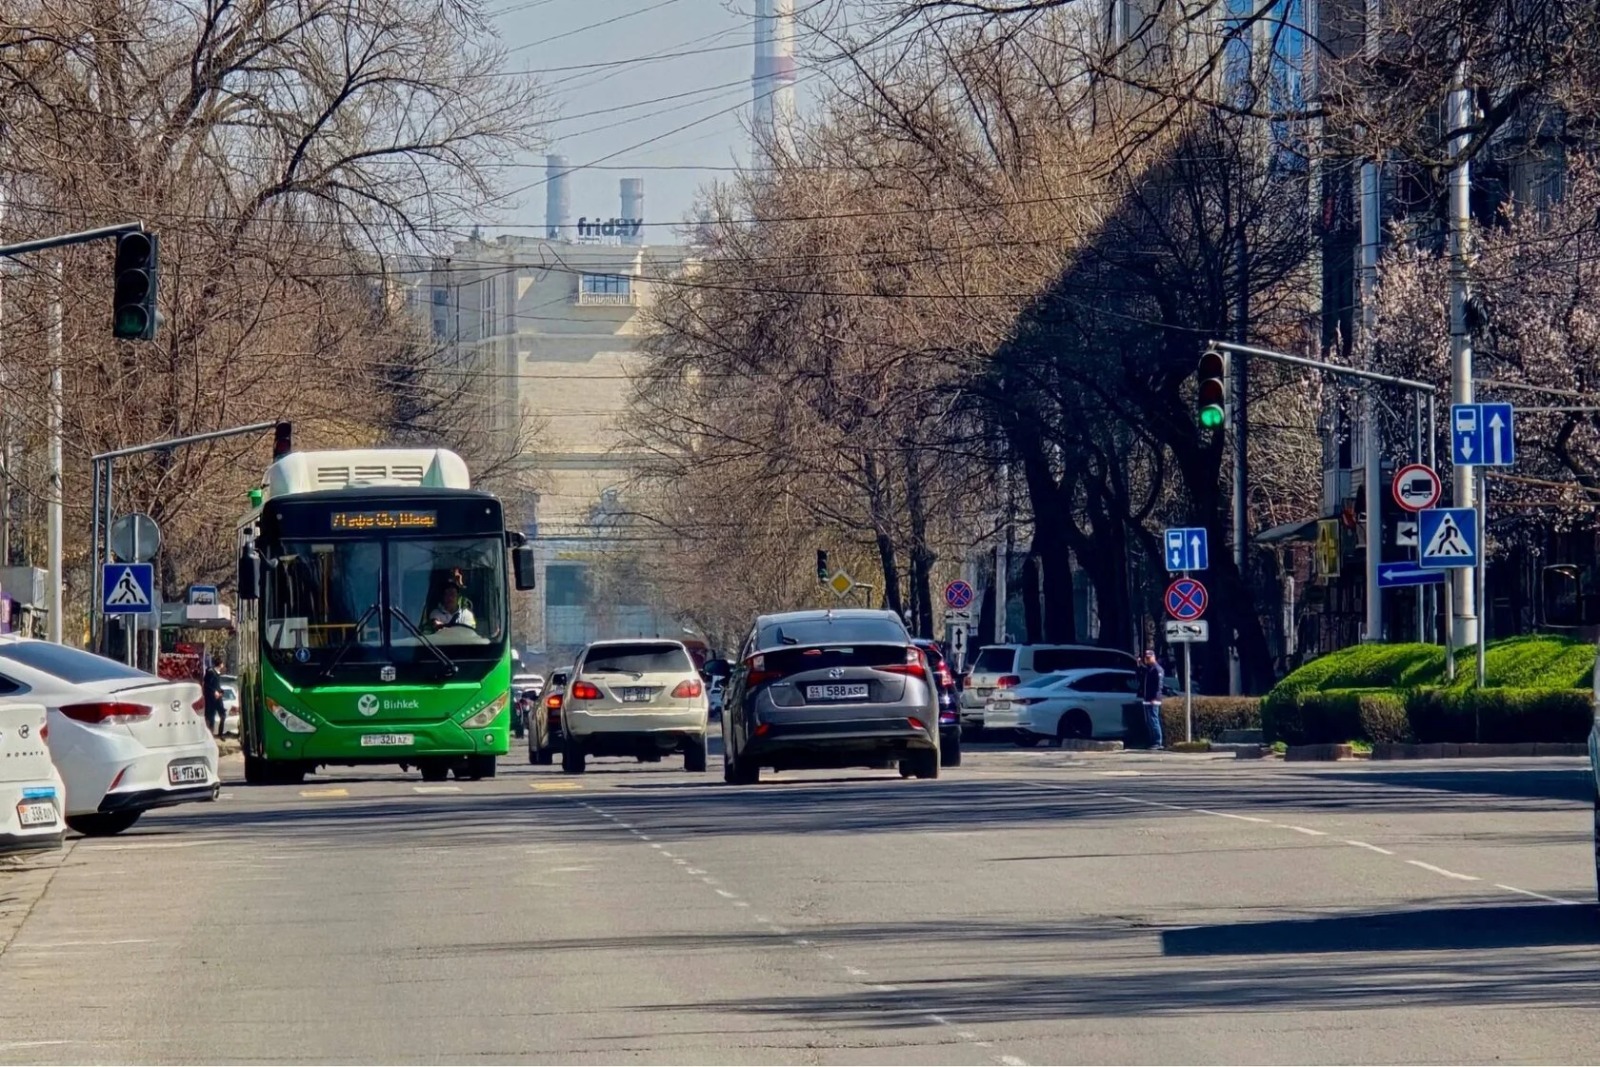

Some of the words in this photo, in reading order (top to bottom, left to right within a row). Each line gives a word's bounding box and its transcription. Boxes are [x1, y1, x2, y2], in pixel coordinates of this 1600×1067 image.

[578, 217, 643, 236] friday
[826, 686, 846, 696] 588
[383, 700, 419, 710] Bishkek
[380, 734, 397, 744] 320
